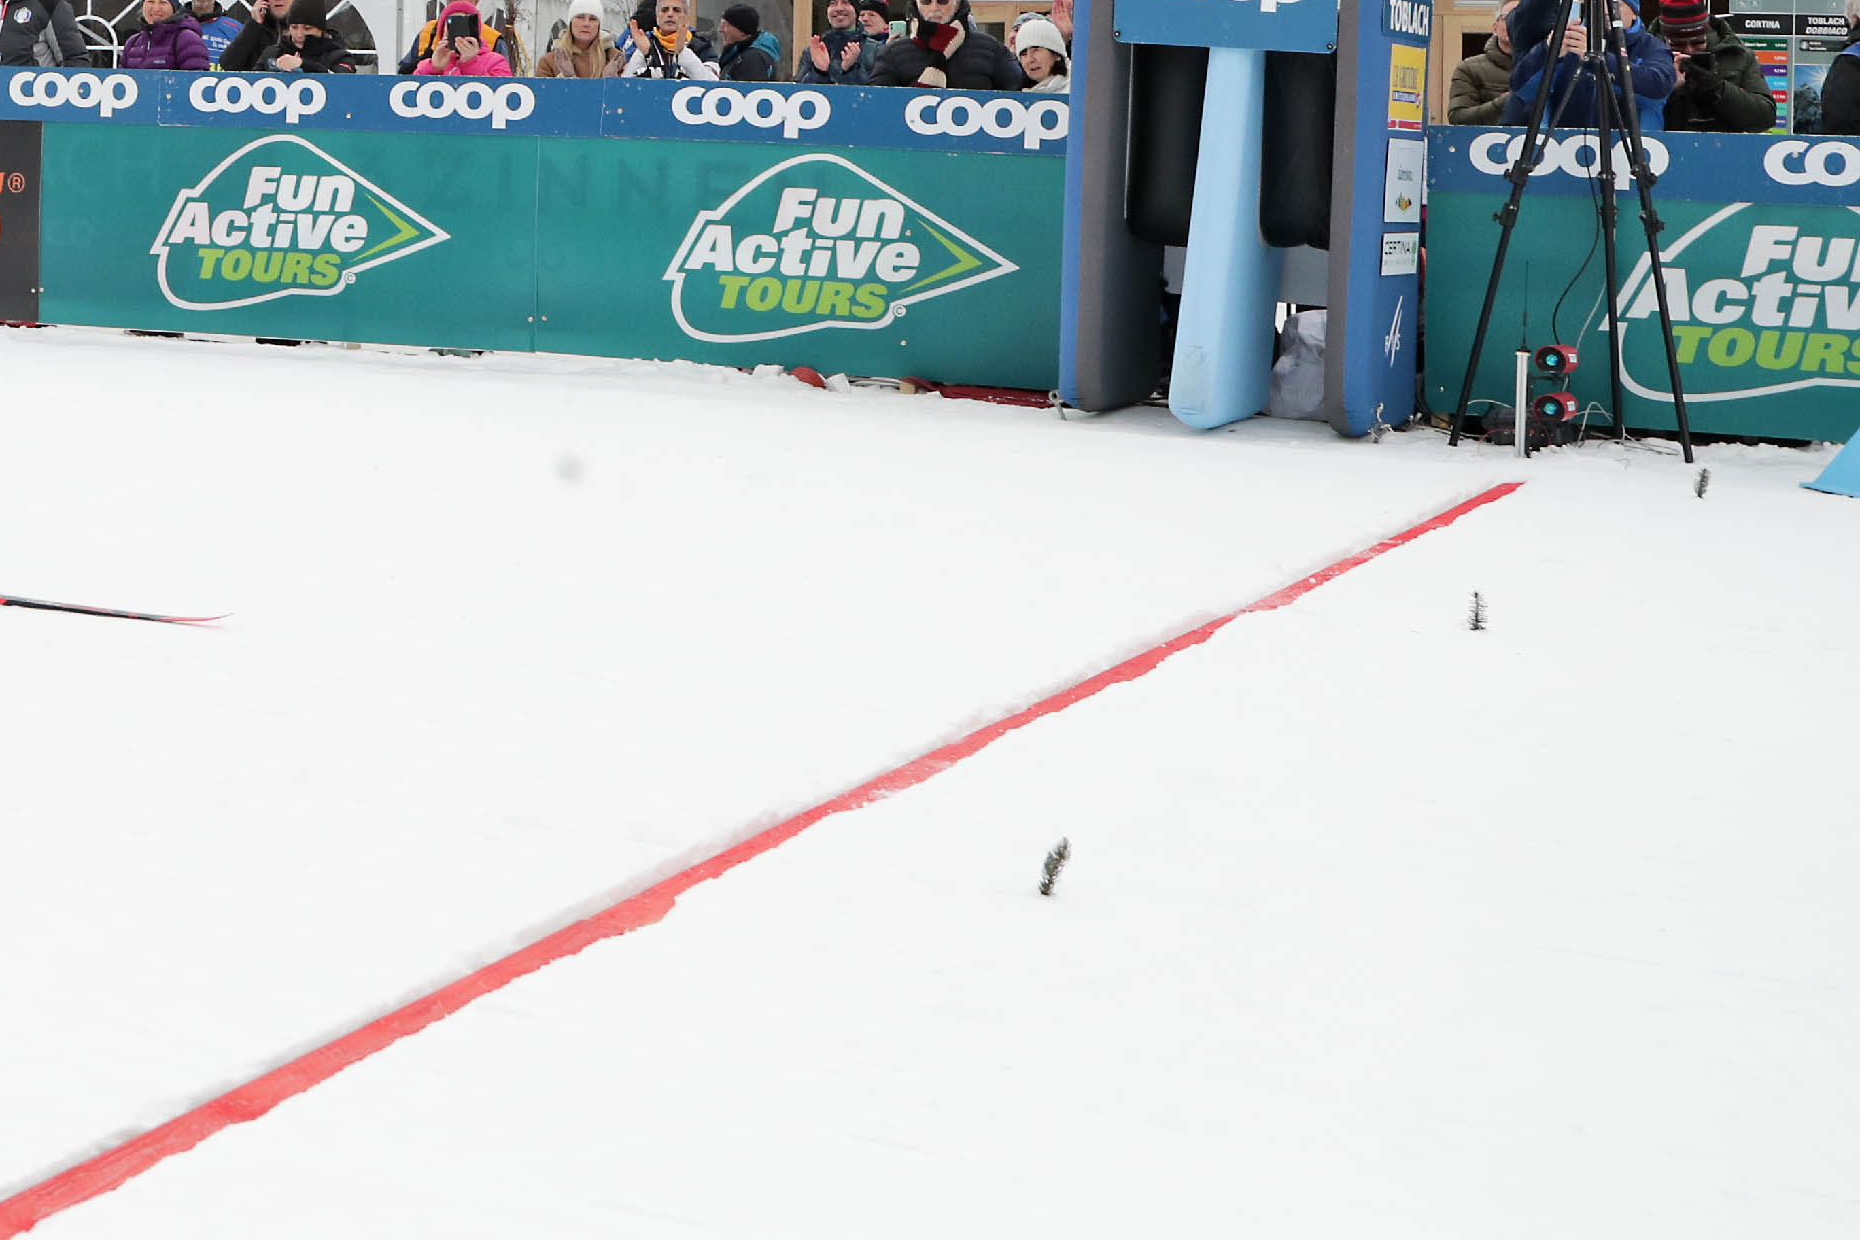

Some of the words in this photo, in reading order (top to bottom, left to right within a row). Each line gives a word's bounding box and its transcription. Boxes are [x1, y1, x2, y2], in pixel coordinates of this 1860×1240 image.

[1744, 19, 1781, 30] CORTINA
[1805, 26, 1848, 36] DOBBIACO
[1807, 16, 1845, 26] TOBLACH
[9, 71, 138, 118] coop
[189, 76, 327, 124] coop
[389, 80, 535, 129] coop
[671, 86, 831, 139] coop
[905, 95, 1071, 150] coop
[1469, 132, 1670, 191] coop
[1763, 140, 1860, 187] co
[243, 166, 355, 212] Fun
[773, 187, 904, 239] Fun
[168, 202, 368, 253] Active
[198, 249, 340, 286] TOURS
[685, 224, 920, 282] Active
[1740, 225, 1860, 282] Fu
[719, 275, 888, 318] TOURS
[1626, 268, 1860, 330] Activ
